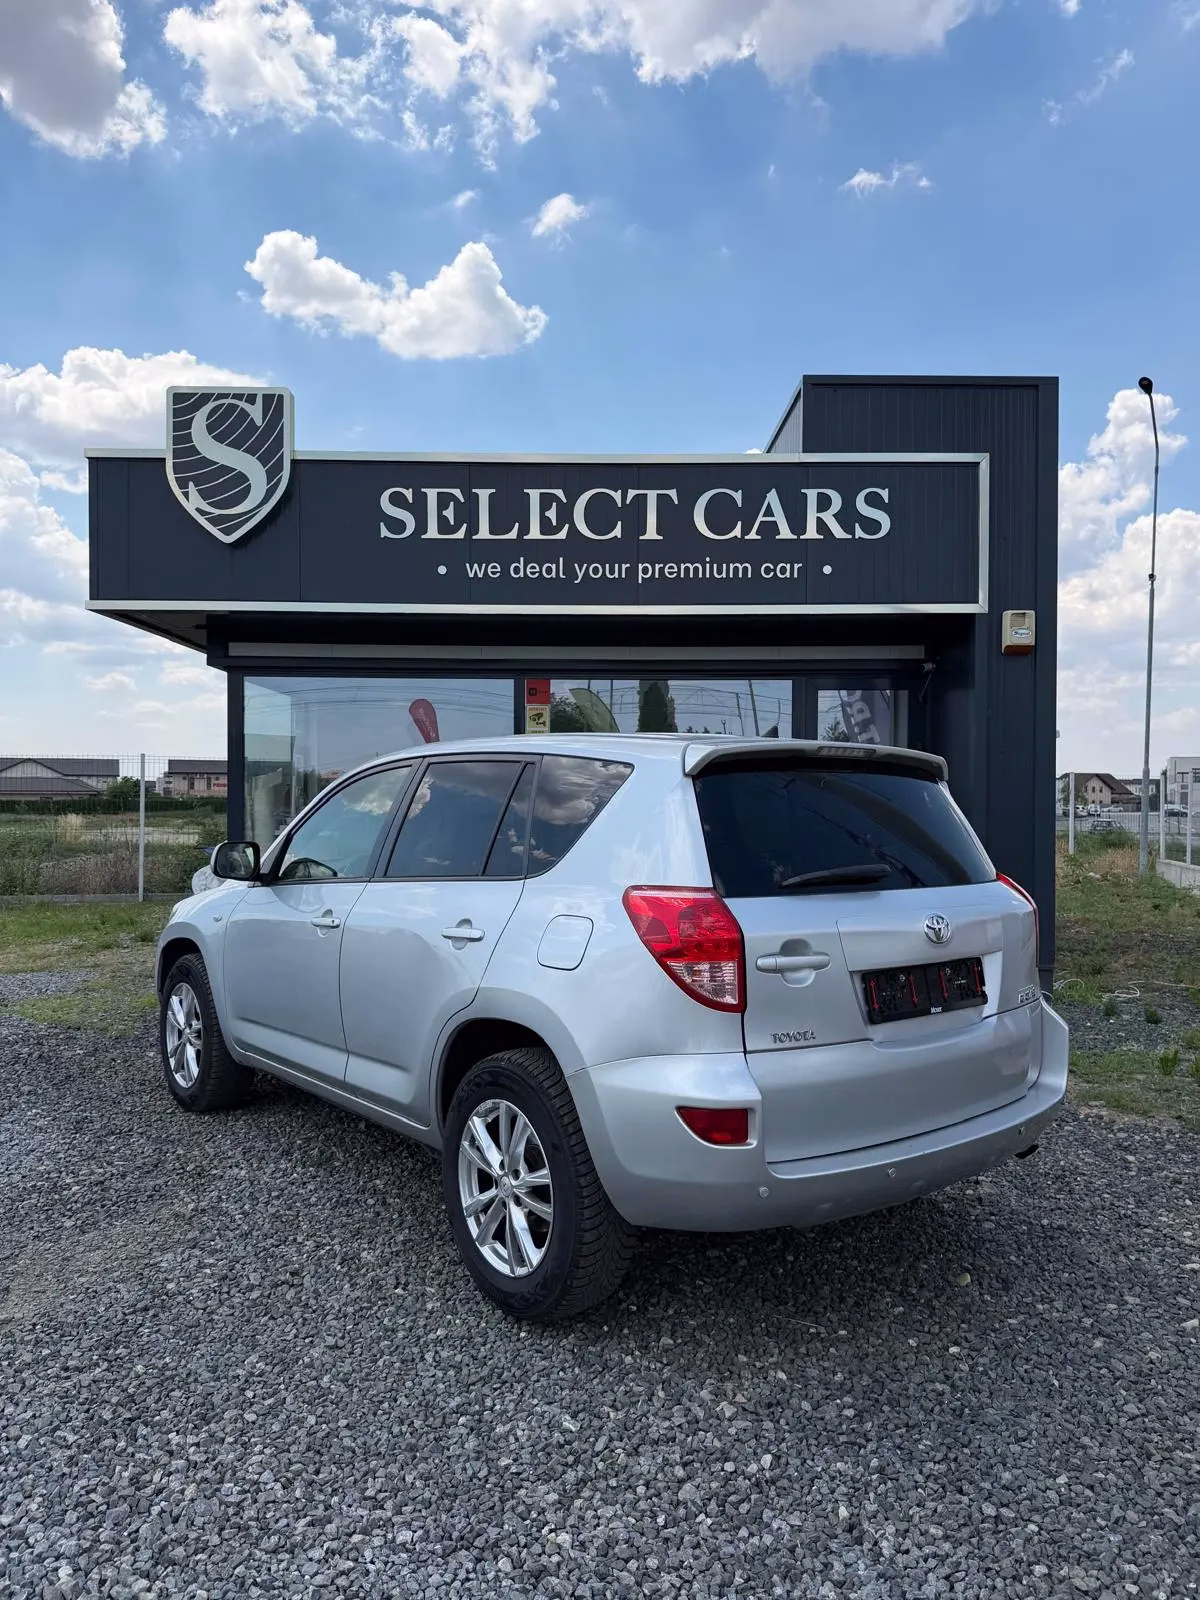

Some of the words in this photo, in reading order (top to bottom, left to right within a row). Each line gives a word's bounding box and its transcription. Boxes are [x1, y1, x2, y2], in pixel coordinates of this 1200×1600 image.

[379, 487, 679, 540] SELECT
[693, 487, 891, 540] CARS
[465, 562, 501, 578] we
[509, 556, 566, 579] deal
[573, 562, 631, 584] your
[637, 556, 752, 584] premium
[760, 562, 803, 579] car
[771, 1030, 816, 1044] TOYOTA
